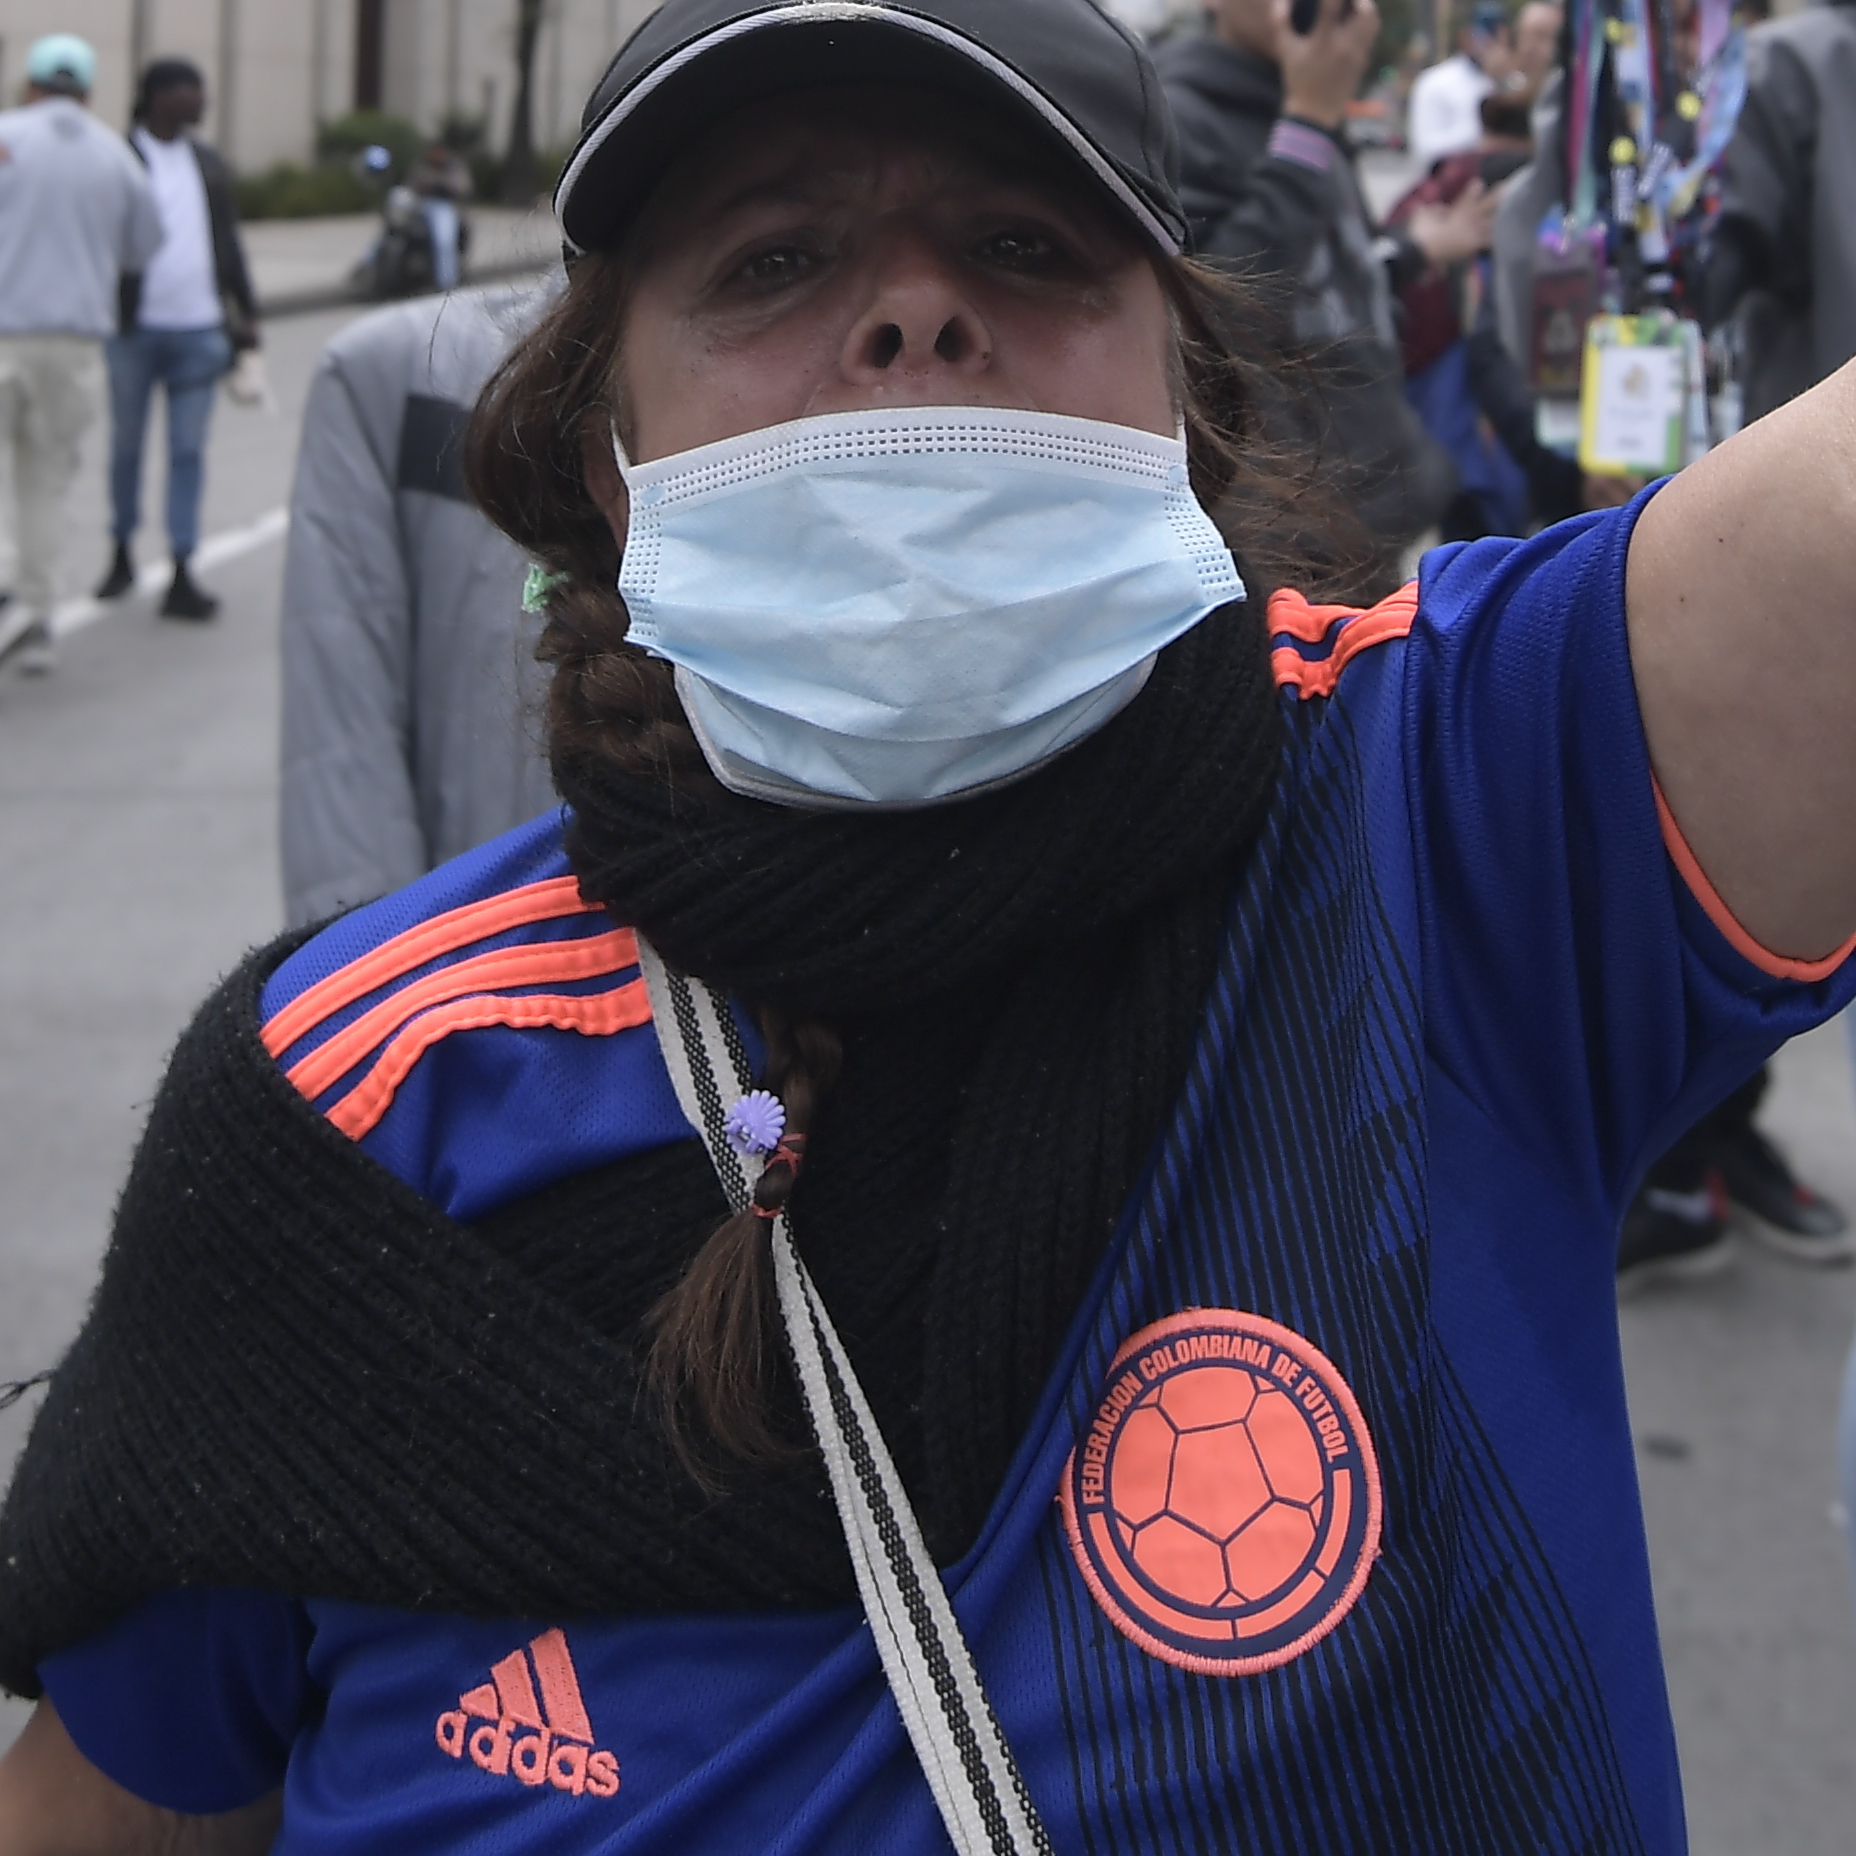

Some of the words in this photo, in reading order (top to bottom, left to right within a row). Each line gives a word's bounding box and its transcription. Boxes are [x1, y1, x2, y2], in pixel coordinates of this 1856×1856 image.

[1080, 1370, 1144, 1505] FEDERACION
[1138, 1334, 1272, 1381] COLOMBIANA
[1271, 1353, 1302, 1388] DE
[1294, 1375, 1349, 1464] FUTBOL
[435, 1709, 622, 1798] adidas
